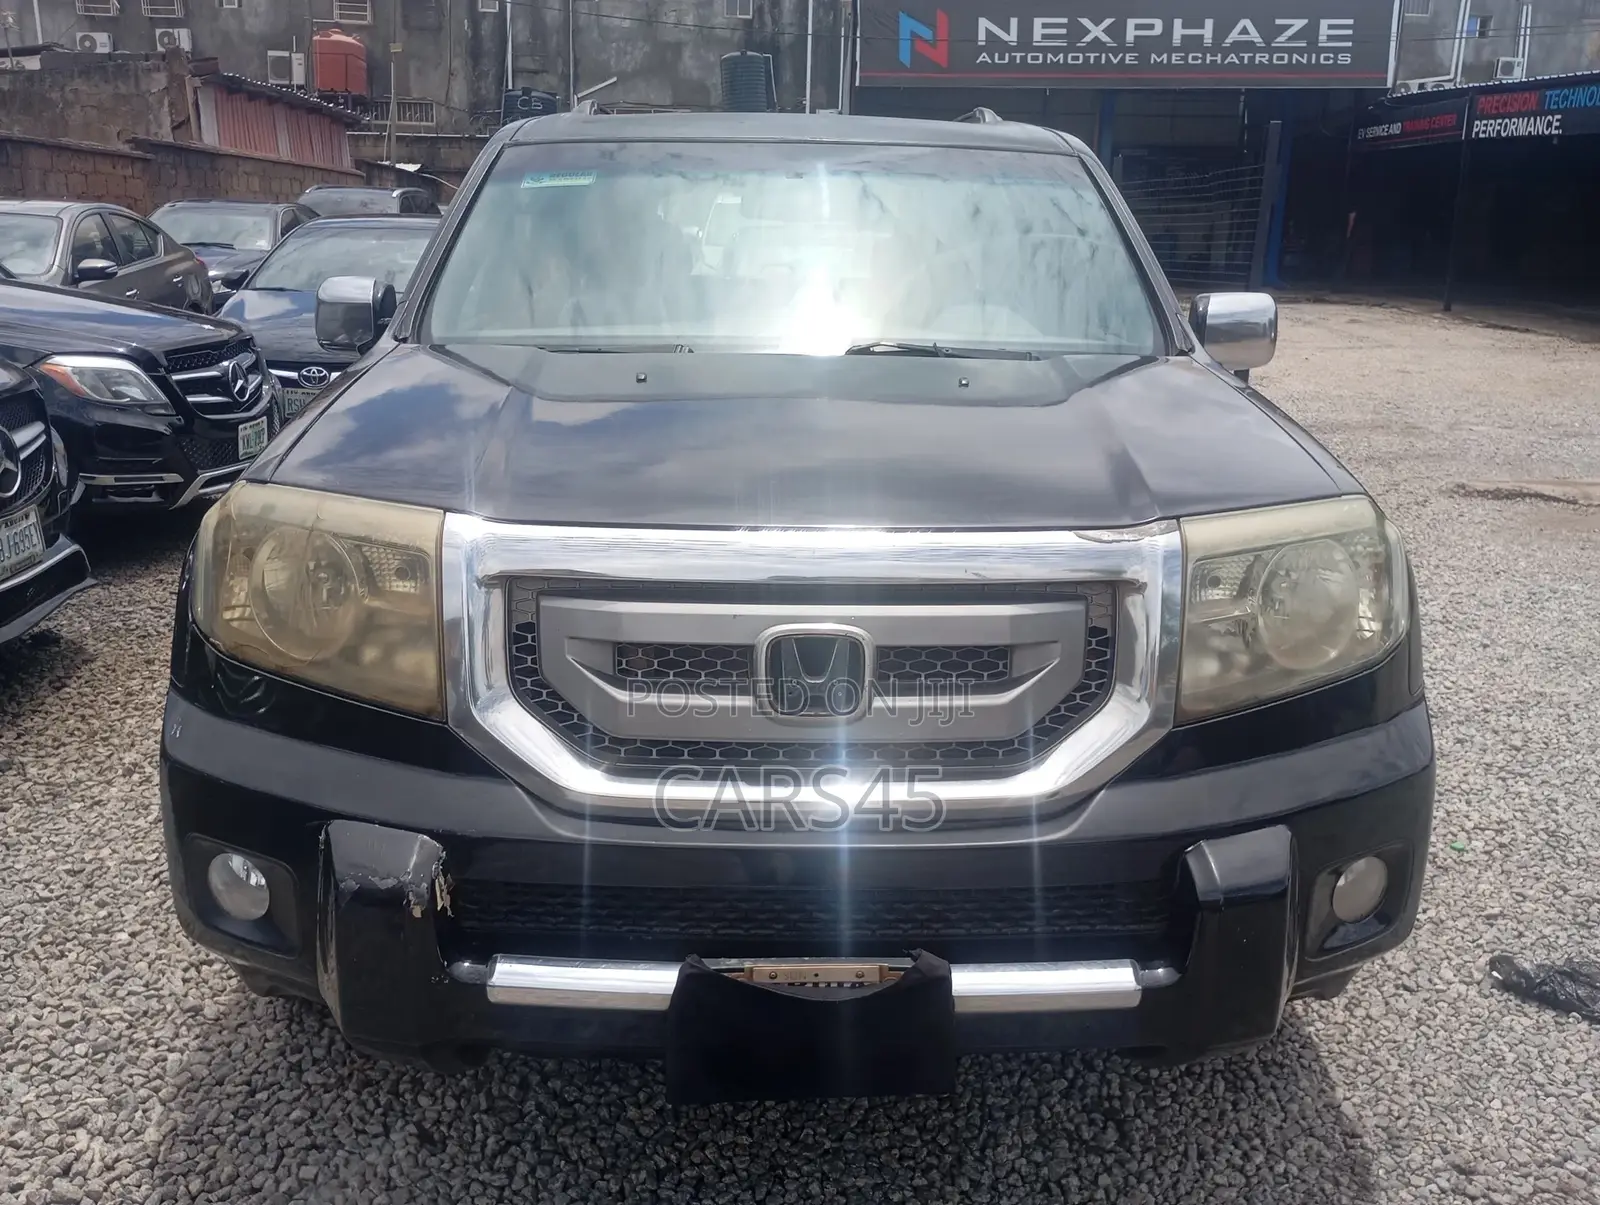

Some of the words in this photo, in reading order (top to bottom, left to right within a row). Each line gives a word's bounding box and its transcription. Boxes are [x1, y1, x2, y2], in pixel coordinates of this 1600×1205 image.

[977, 17, 1354, 47] NEXPHAZE
[976, 52, 1139, 65] AUTOMOTIVE
[1150, 53, 1352, 65] MECHATRONICS
[1472, 114, 1563, 138] PERFORMANCE.
